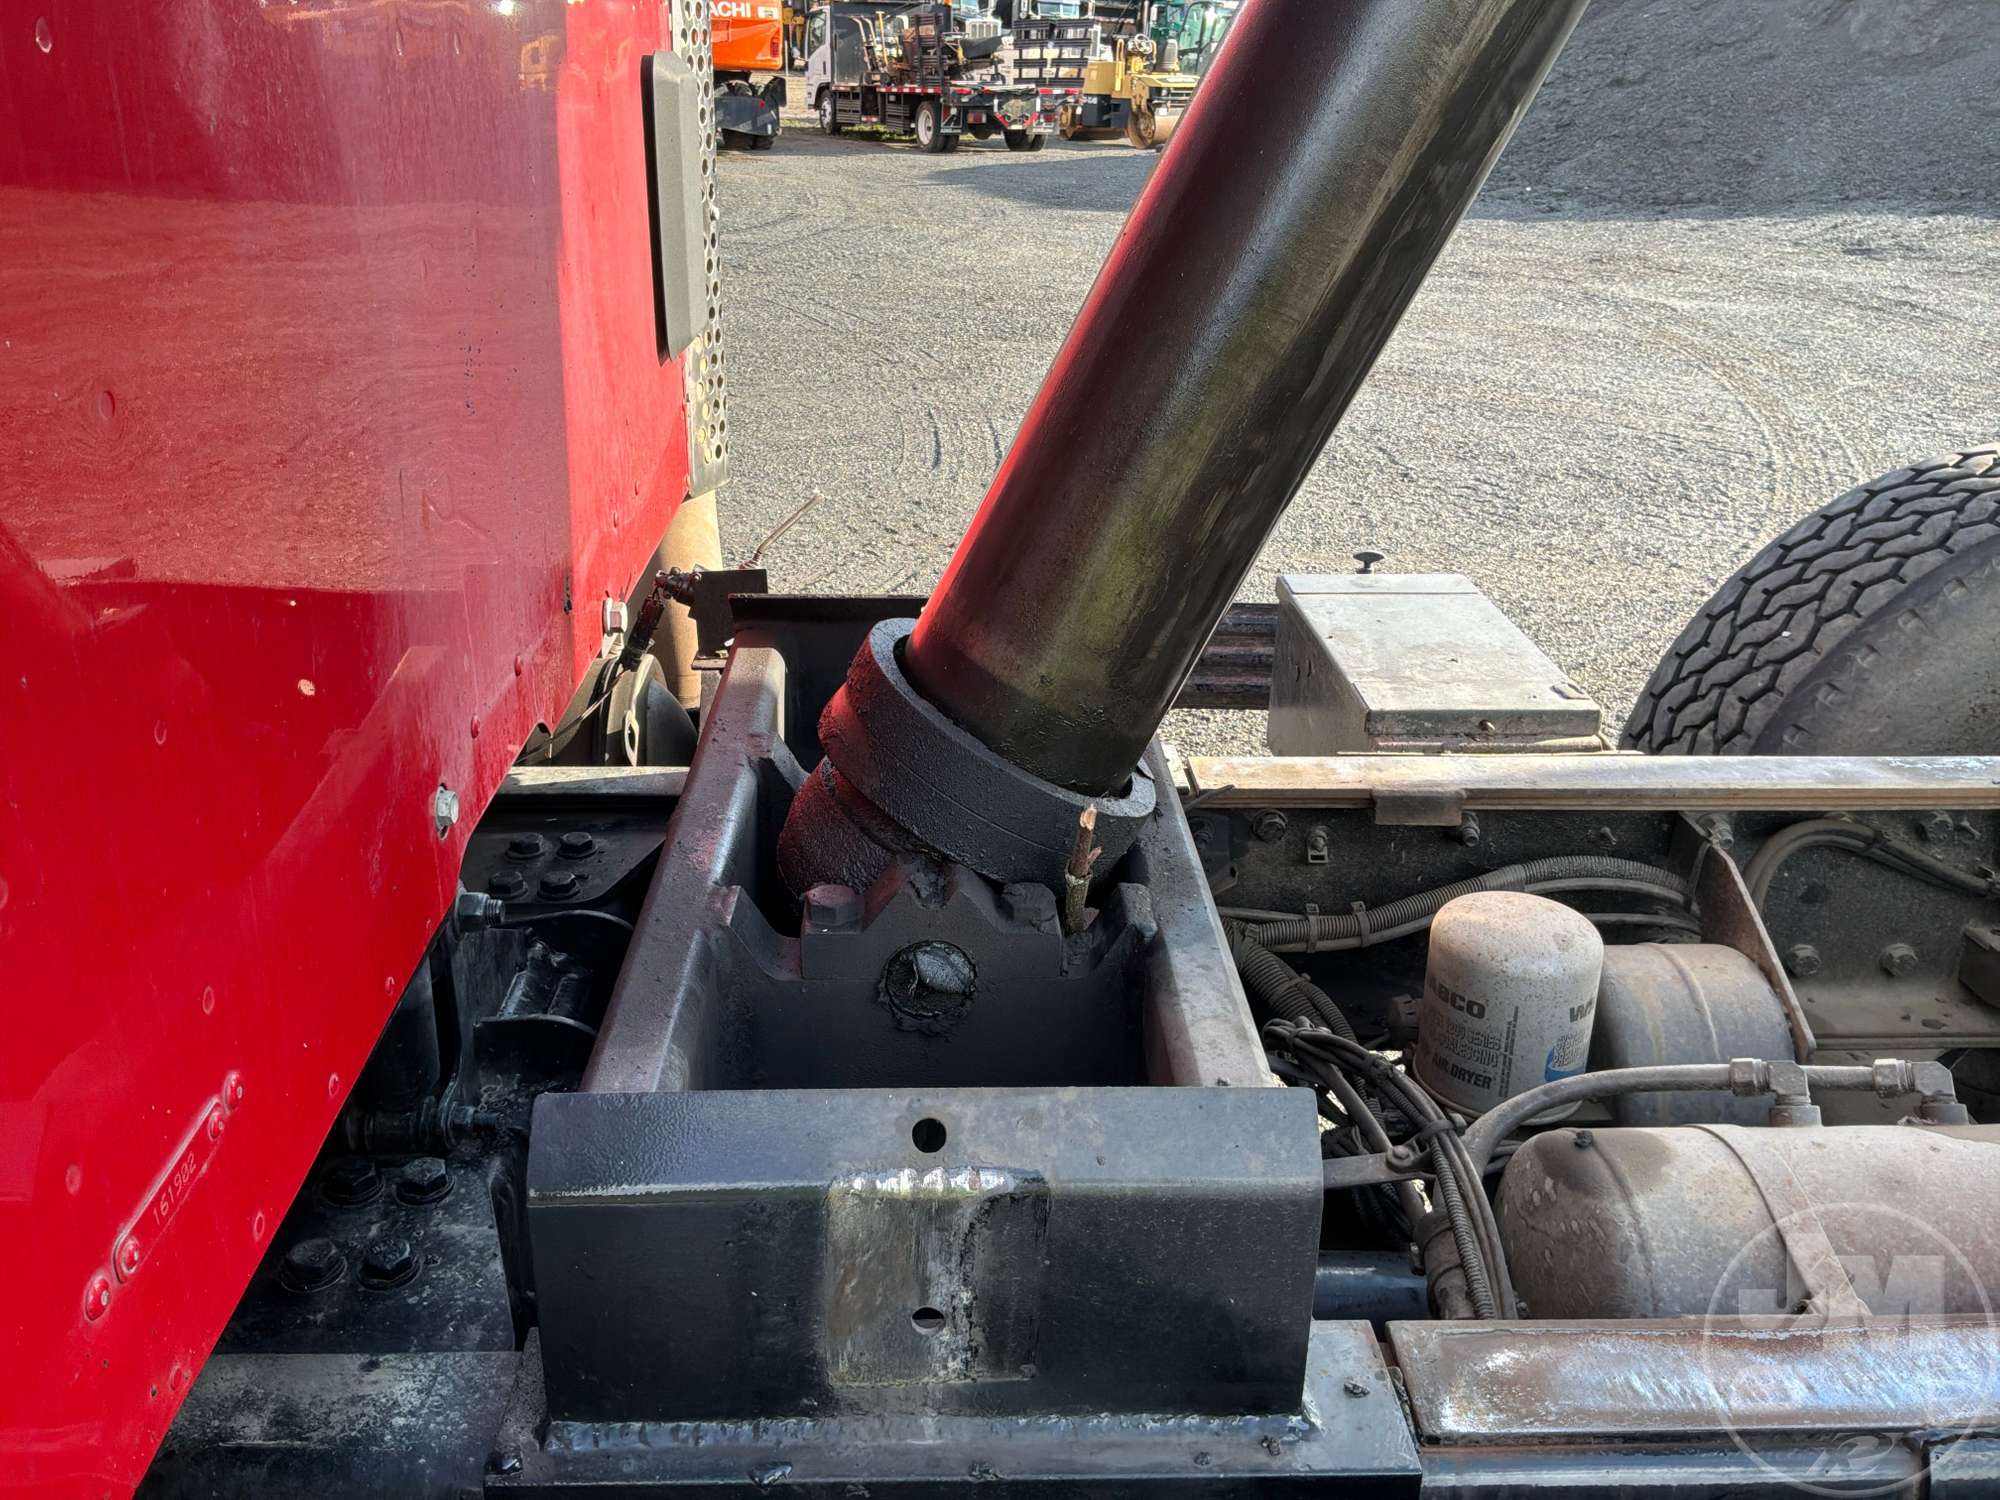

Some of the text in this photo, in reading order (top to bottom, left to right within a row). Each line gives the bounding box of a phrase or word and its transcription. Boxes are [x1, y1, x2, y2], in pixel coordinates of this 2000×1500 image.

[709, 1, 752, 18] ACHI
[1432, 1052, 1492, 1089] AIR DRYER
